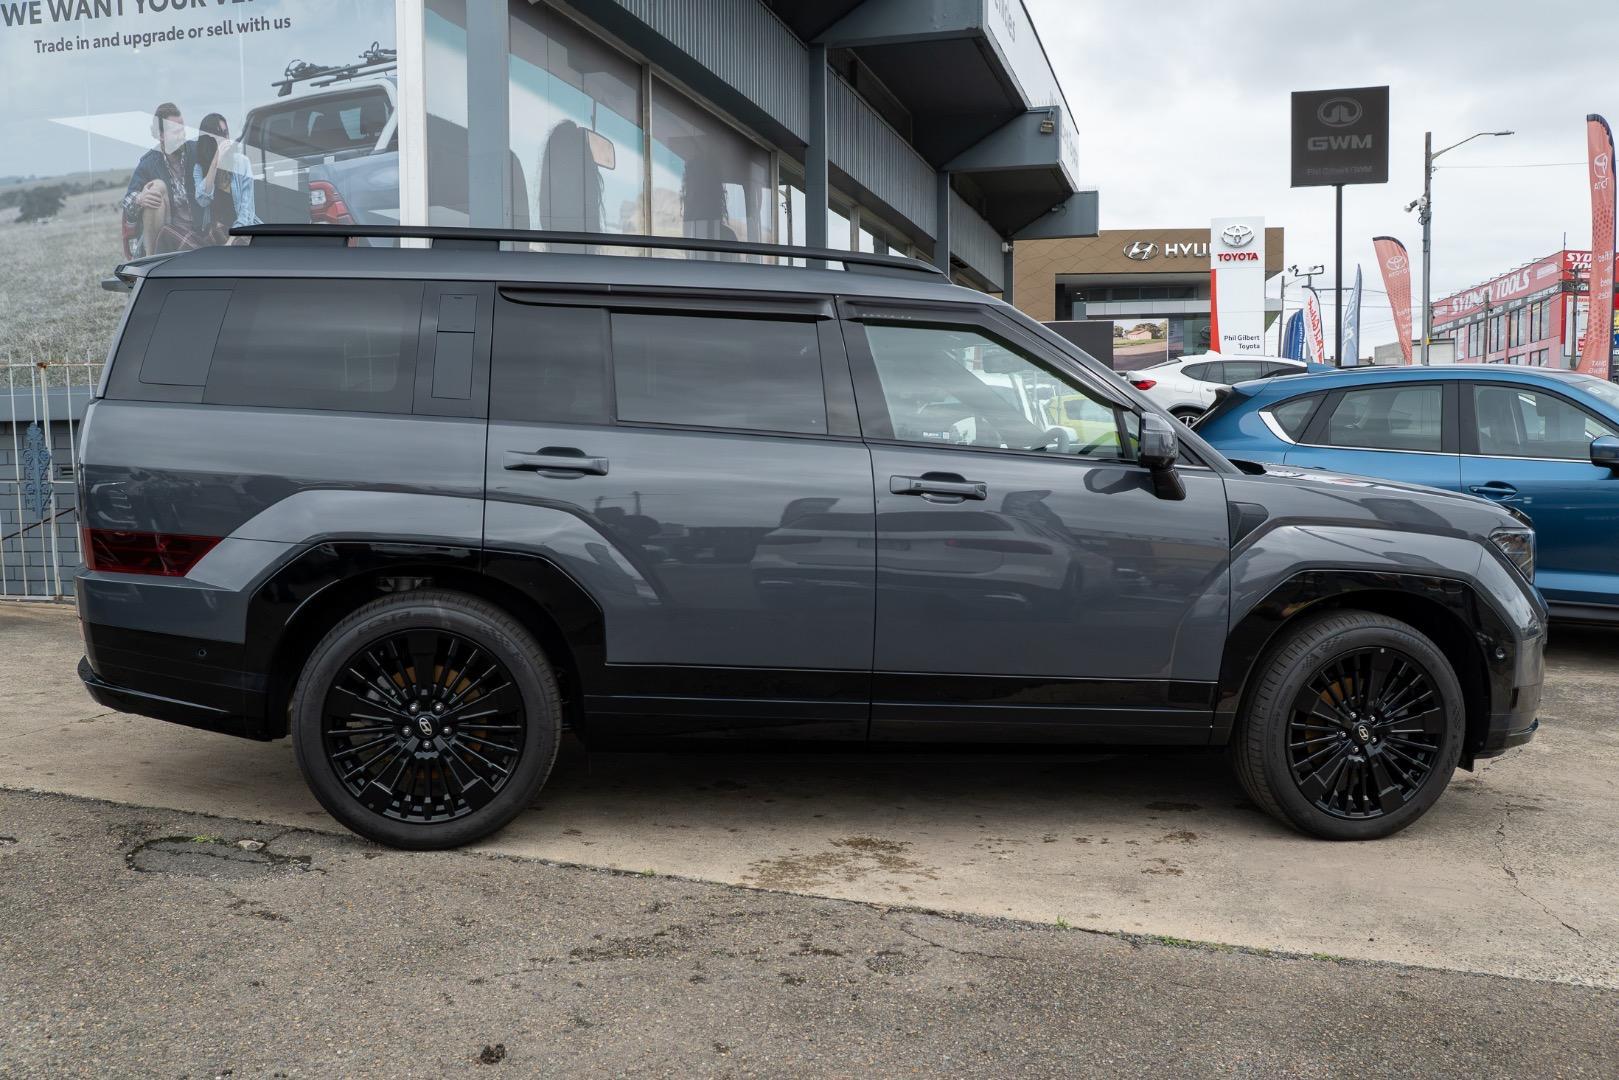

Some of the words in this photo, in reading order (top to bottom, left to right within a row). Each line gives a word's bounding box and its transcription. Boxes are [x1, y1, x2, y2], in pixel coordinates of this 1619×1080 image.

[0, 1, 42, 26] WE
[46, 0, 123, 22] WANT
[34, 39, 73, 53] Trade
[76, 37, 90, 50] in
[93, 32, 120, 48] and
[123, 26, 184, 48] upgrade
[188, 27, 203, 39] or
[207, 20, 233, 37] sell
[236, 16, 270, 34] with
[273, 17, 291, 29] us
[1307, 134, 1373, 151] GWM
[1165, 242, 1211, 257] HYU
[1217, 252, 1259, 262] TOYOTA
[1495, 268, 1532, 299] TOOLS
